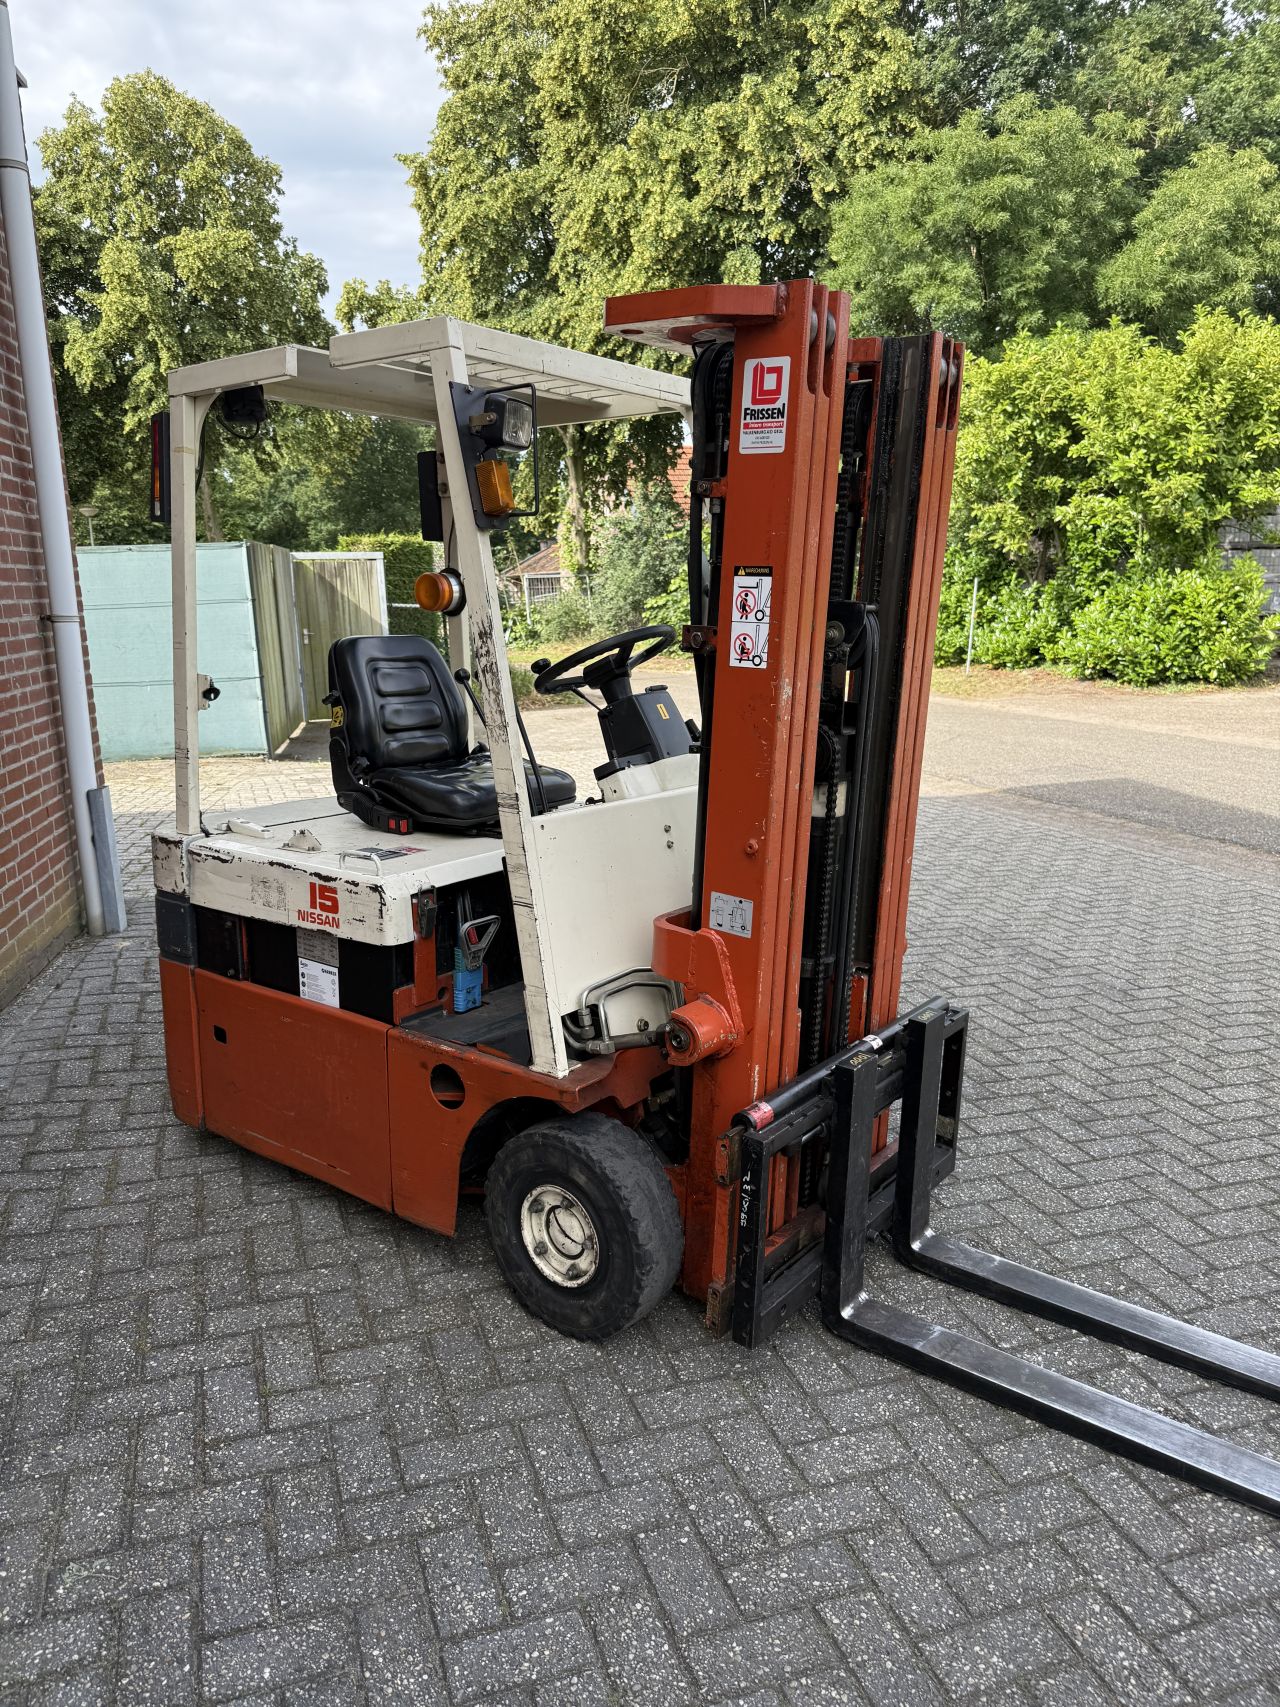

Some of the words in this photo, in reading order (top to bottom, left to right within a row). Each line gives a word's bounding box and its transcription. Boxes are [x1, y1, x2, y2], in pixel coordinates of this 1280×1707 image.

[743, 403, 785, 421] FRISSEN
[309, 881, 339, 915] 15
[297, 909, 340, 929] NISSAN
